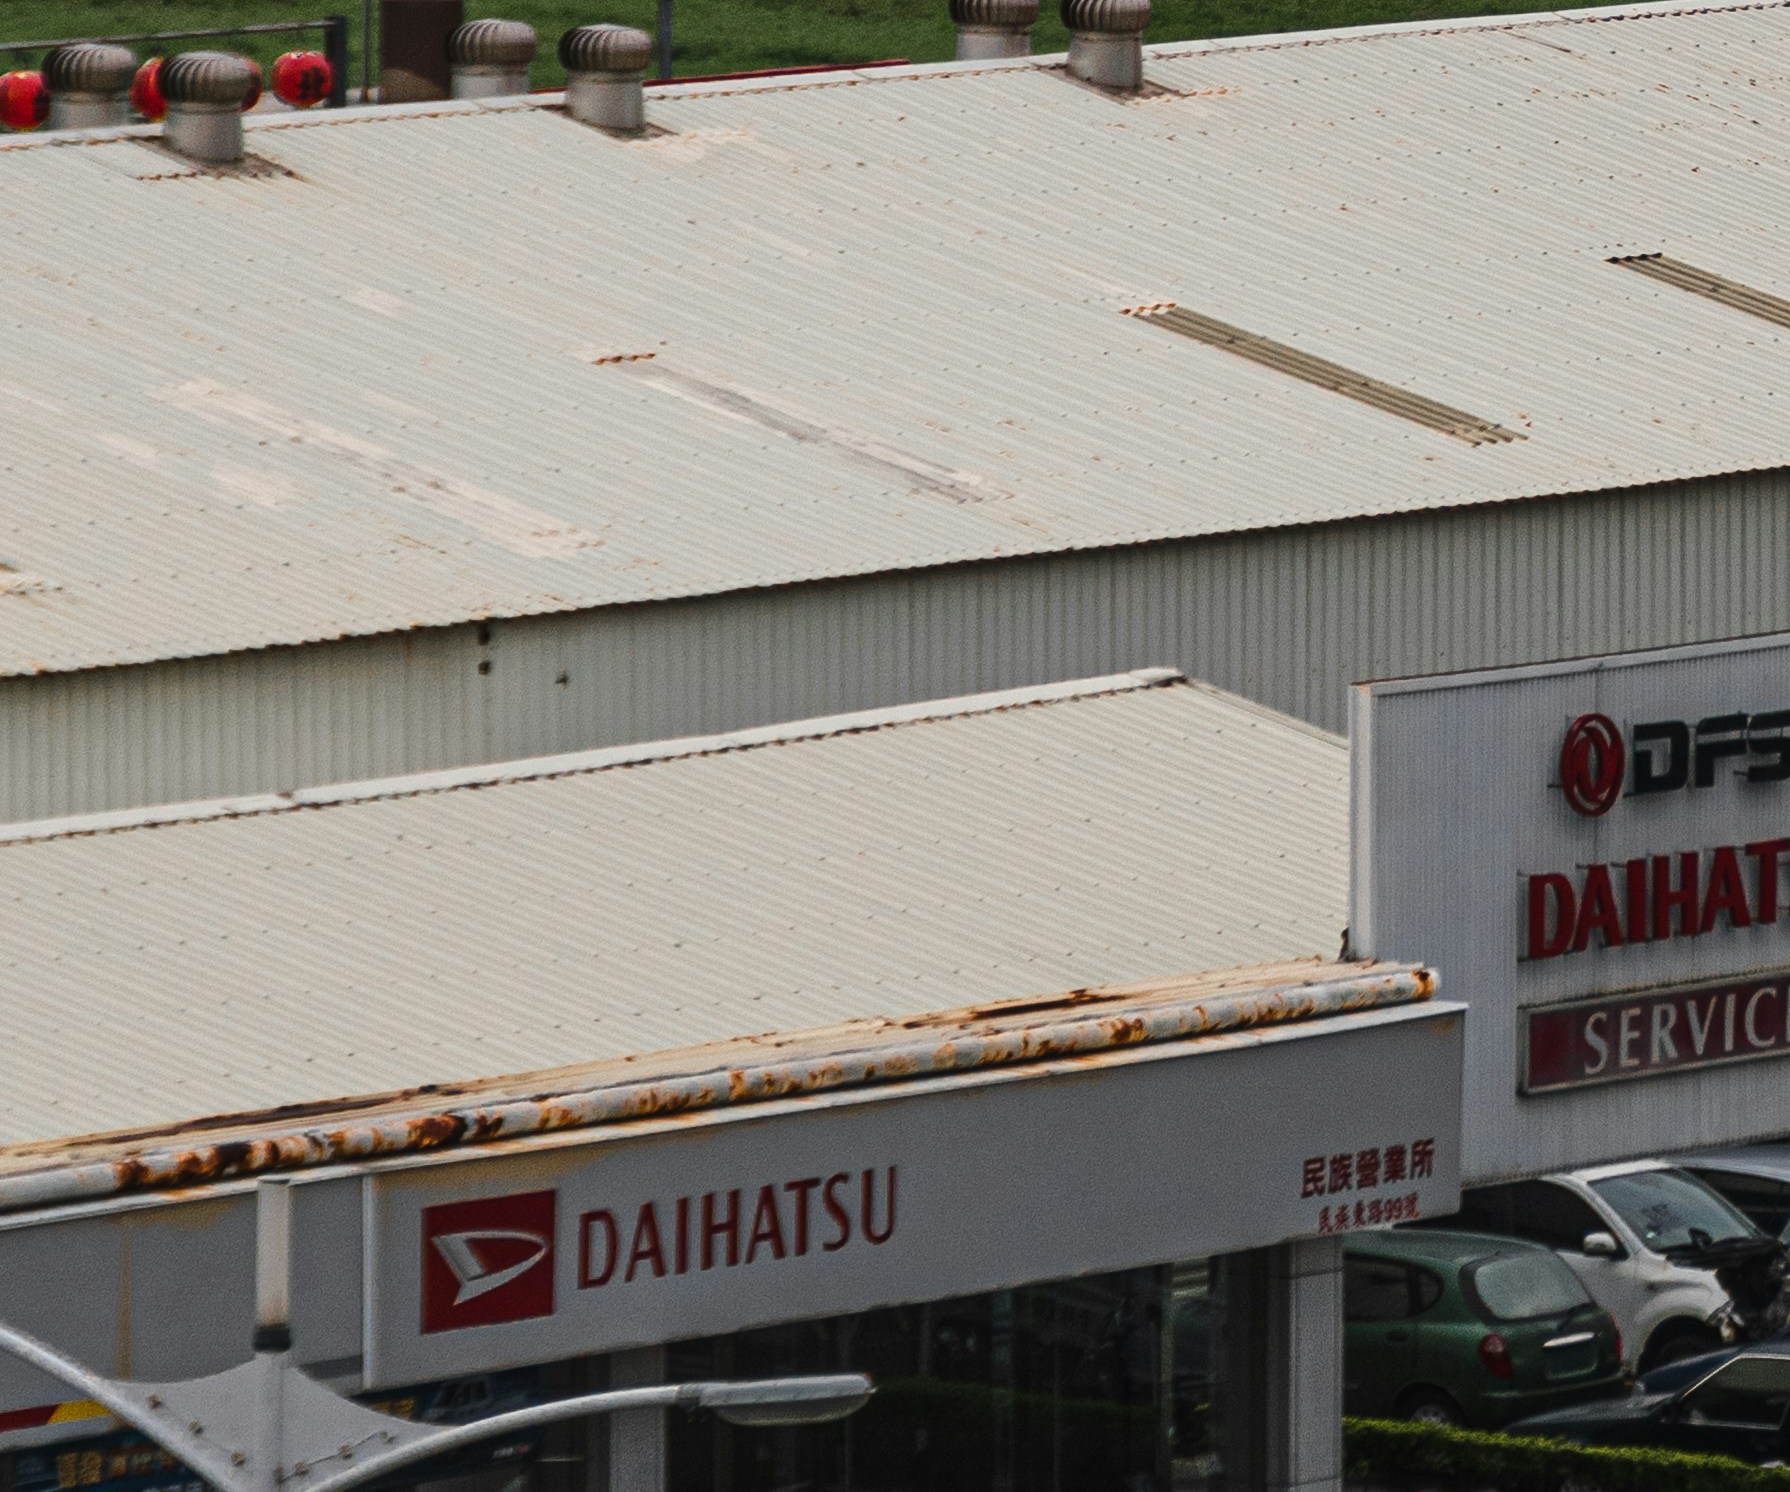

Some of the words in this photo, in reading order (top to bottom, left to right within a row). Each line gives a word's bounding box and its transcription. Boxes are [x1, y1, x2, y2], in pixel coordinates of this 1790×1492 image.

[1301, 1137, 1436, 1199] 民族營業所
[576, 1165, 897, 1291] DAIHATSU
